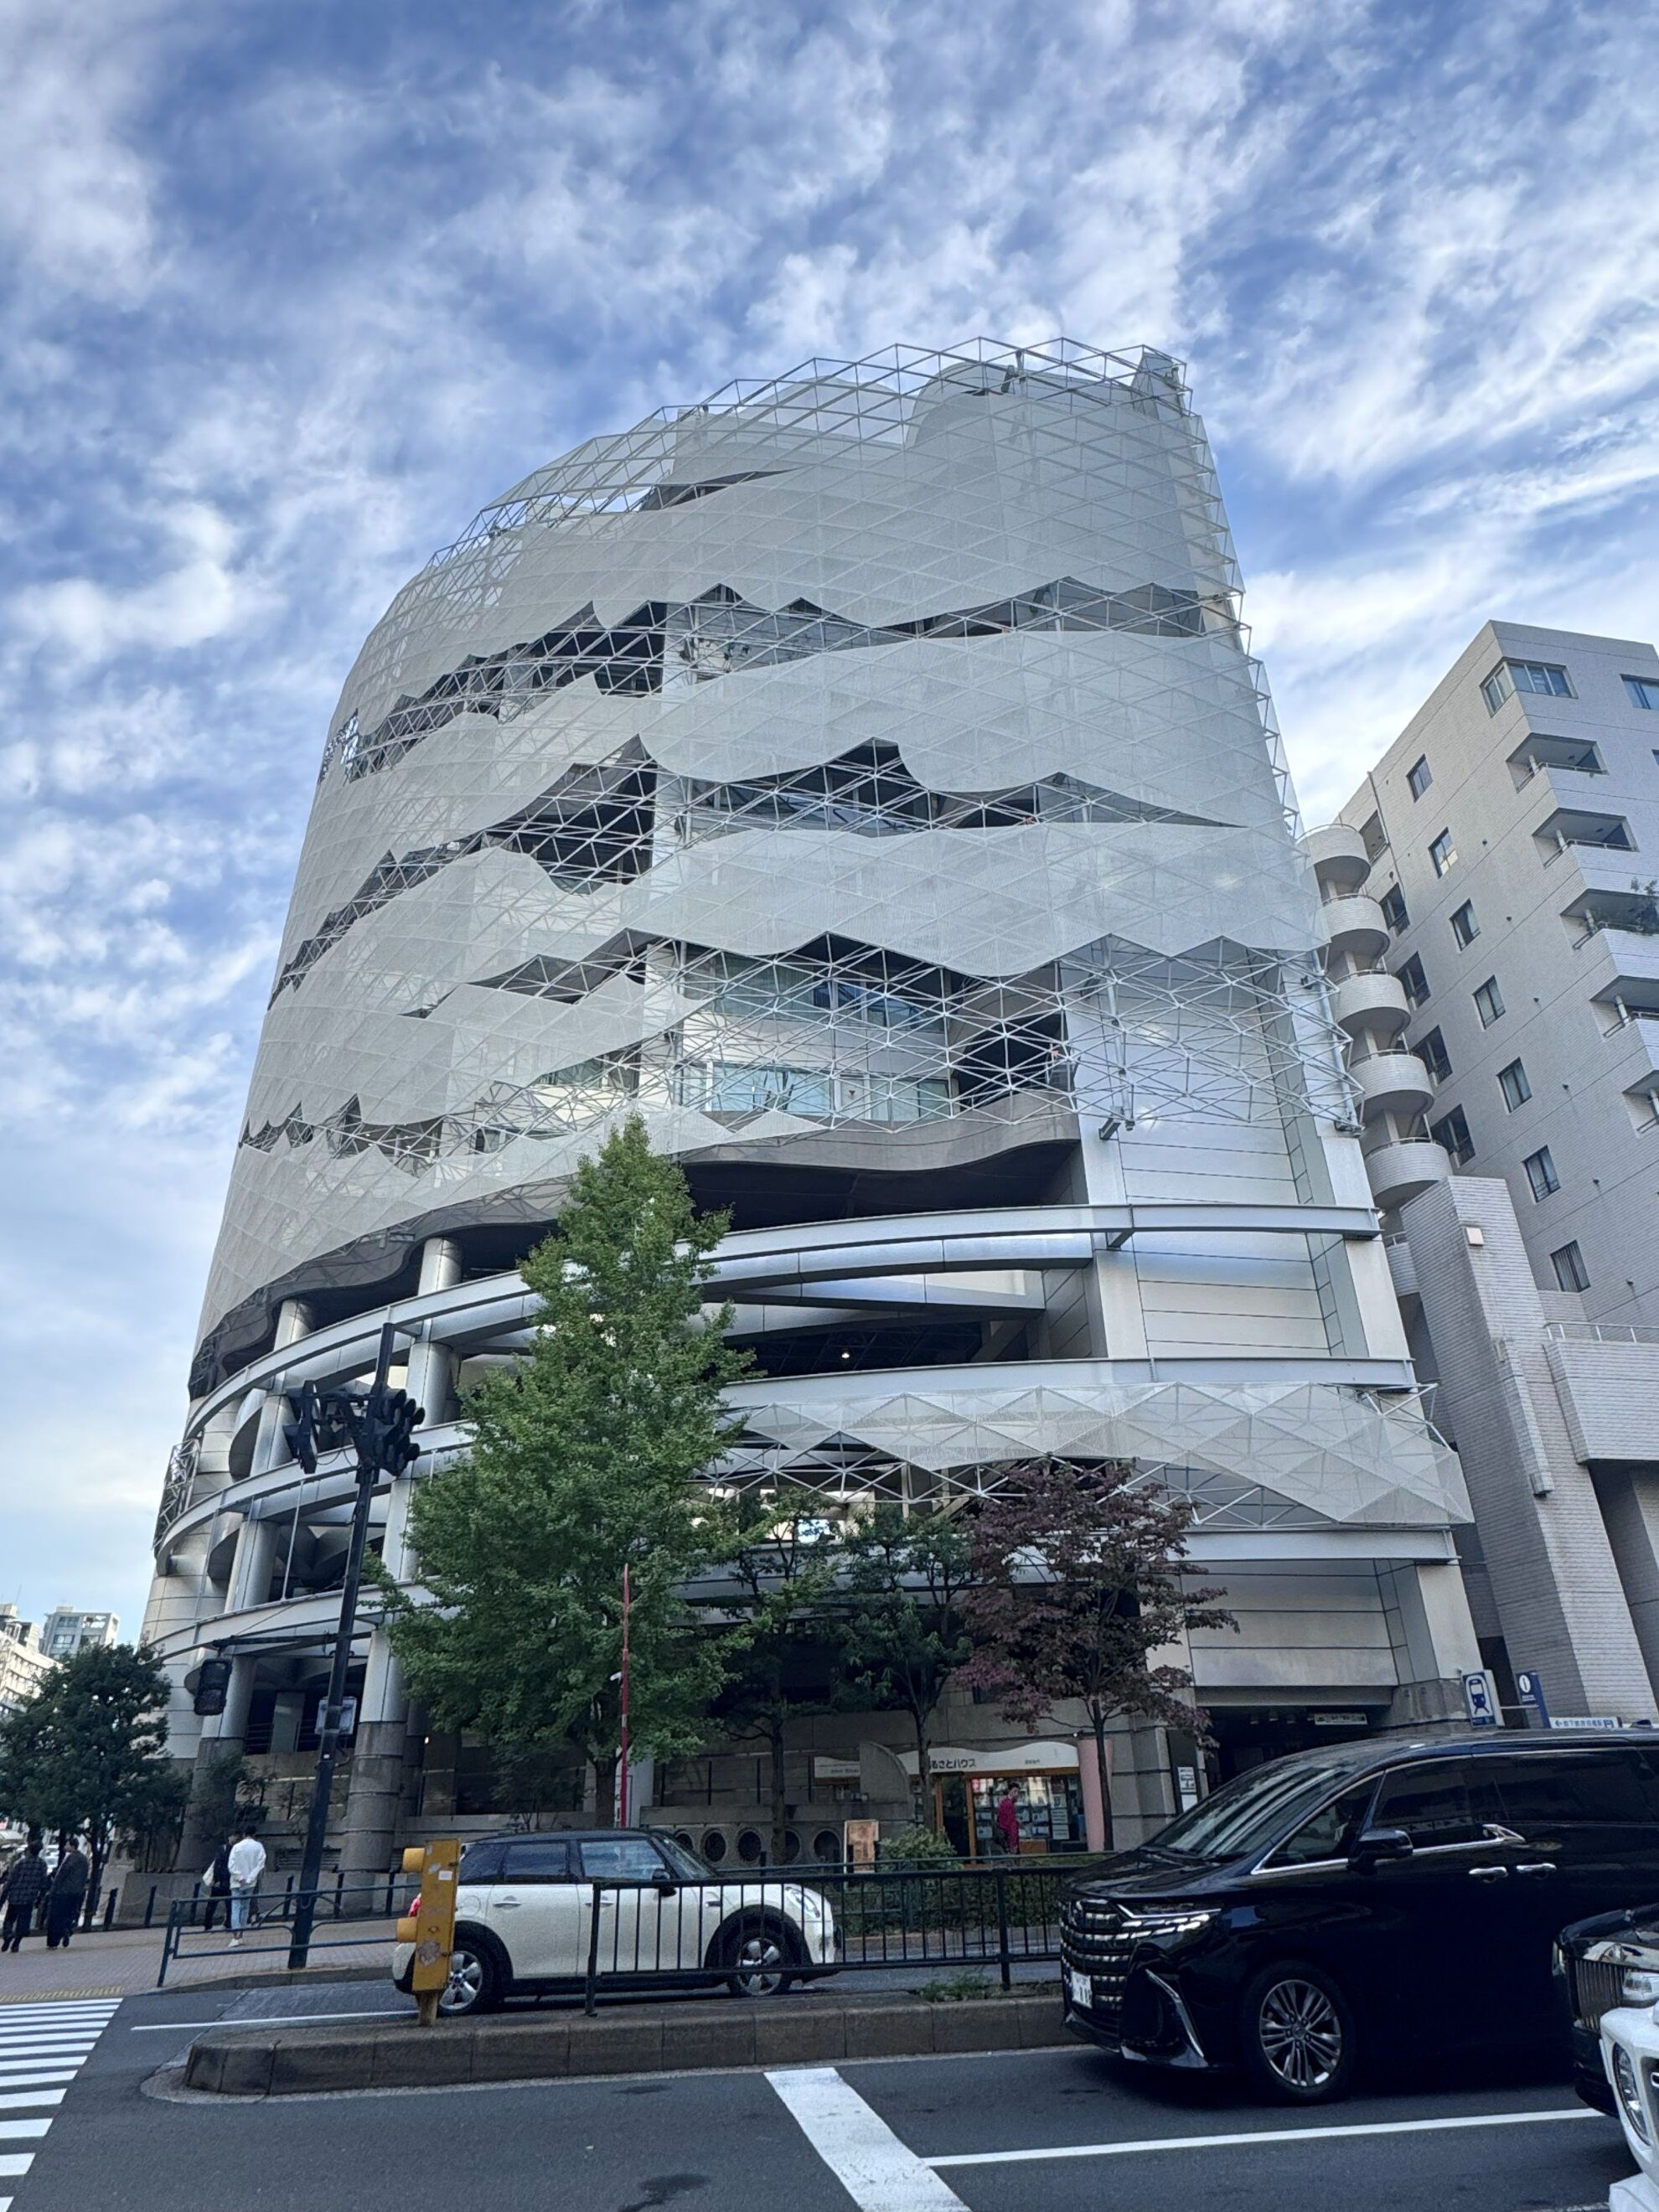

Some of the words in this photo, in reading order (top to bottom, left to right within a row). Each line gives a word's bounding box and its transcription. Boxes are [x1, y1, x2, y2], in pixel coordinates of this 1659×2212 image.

[929, 1758, 976, 1770] るさとハウス
